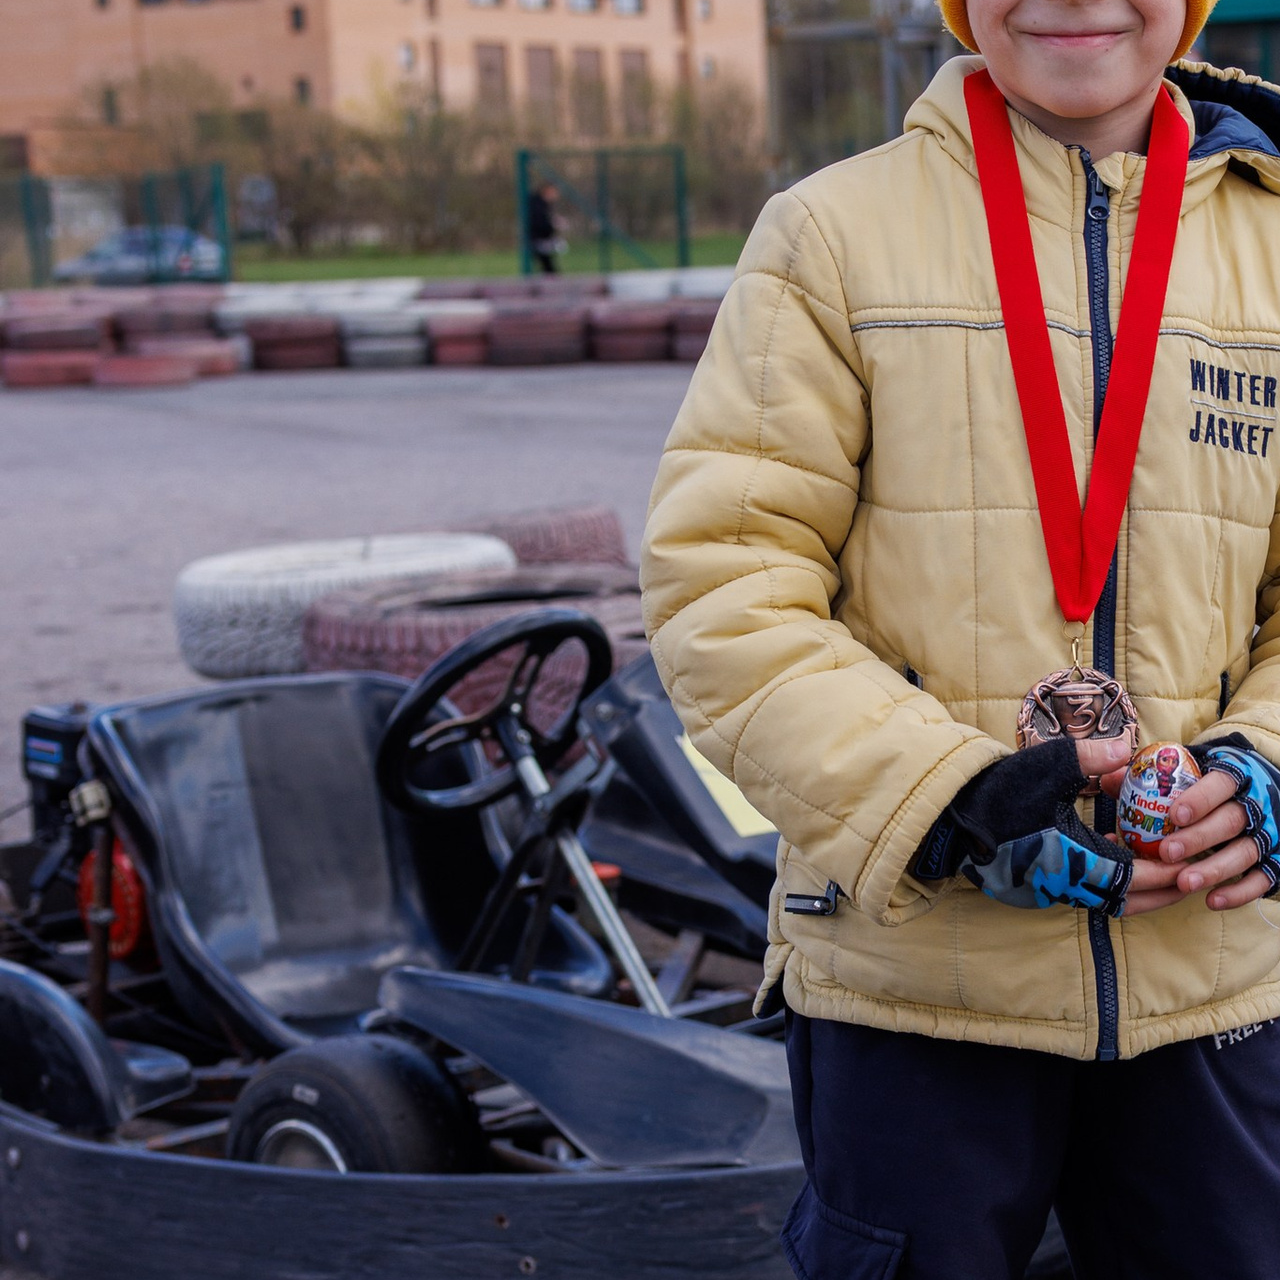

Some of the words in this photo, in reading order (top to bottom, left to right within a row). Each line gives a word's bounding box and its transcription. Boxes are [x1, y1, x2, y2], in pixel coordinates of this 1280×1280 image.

[1190, 358, 1278, 408] WINTER
[1189, 411, 1274, 458] JACKET
[1066, 696, 1096, 732] 3
[1119, 799, 1175, 836] СЮРПРИ
[928, 824, 948, 874] SPORT
